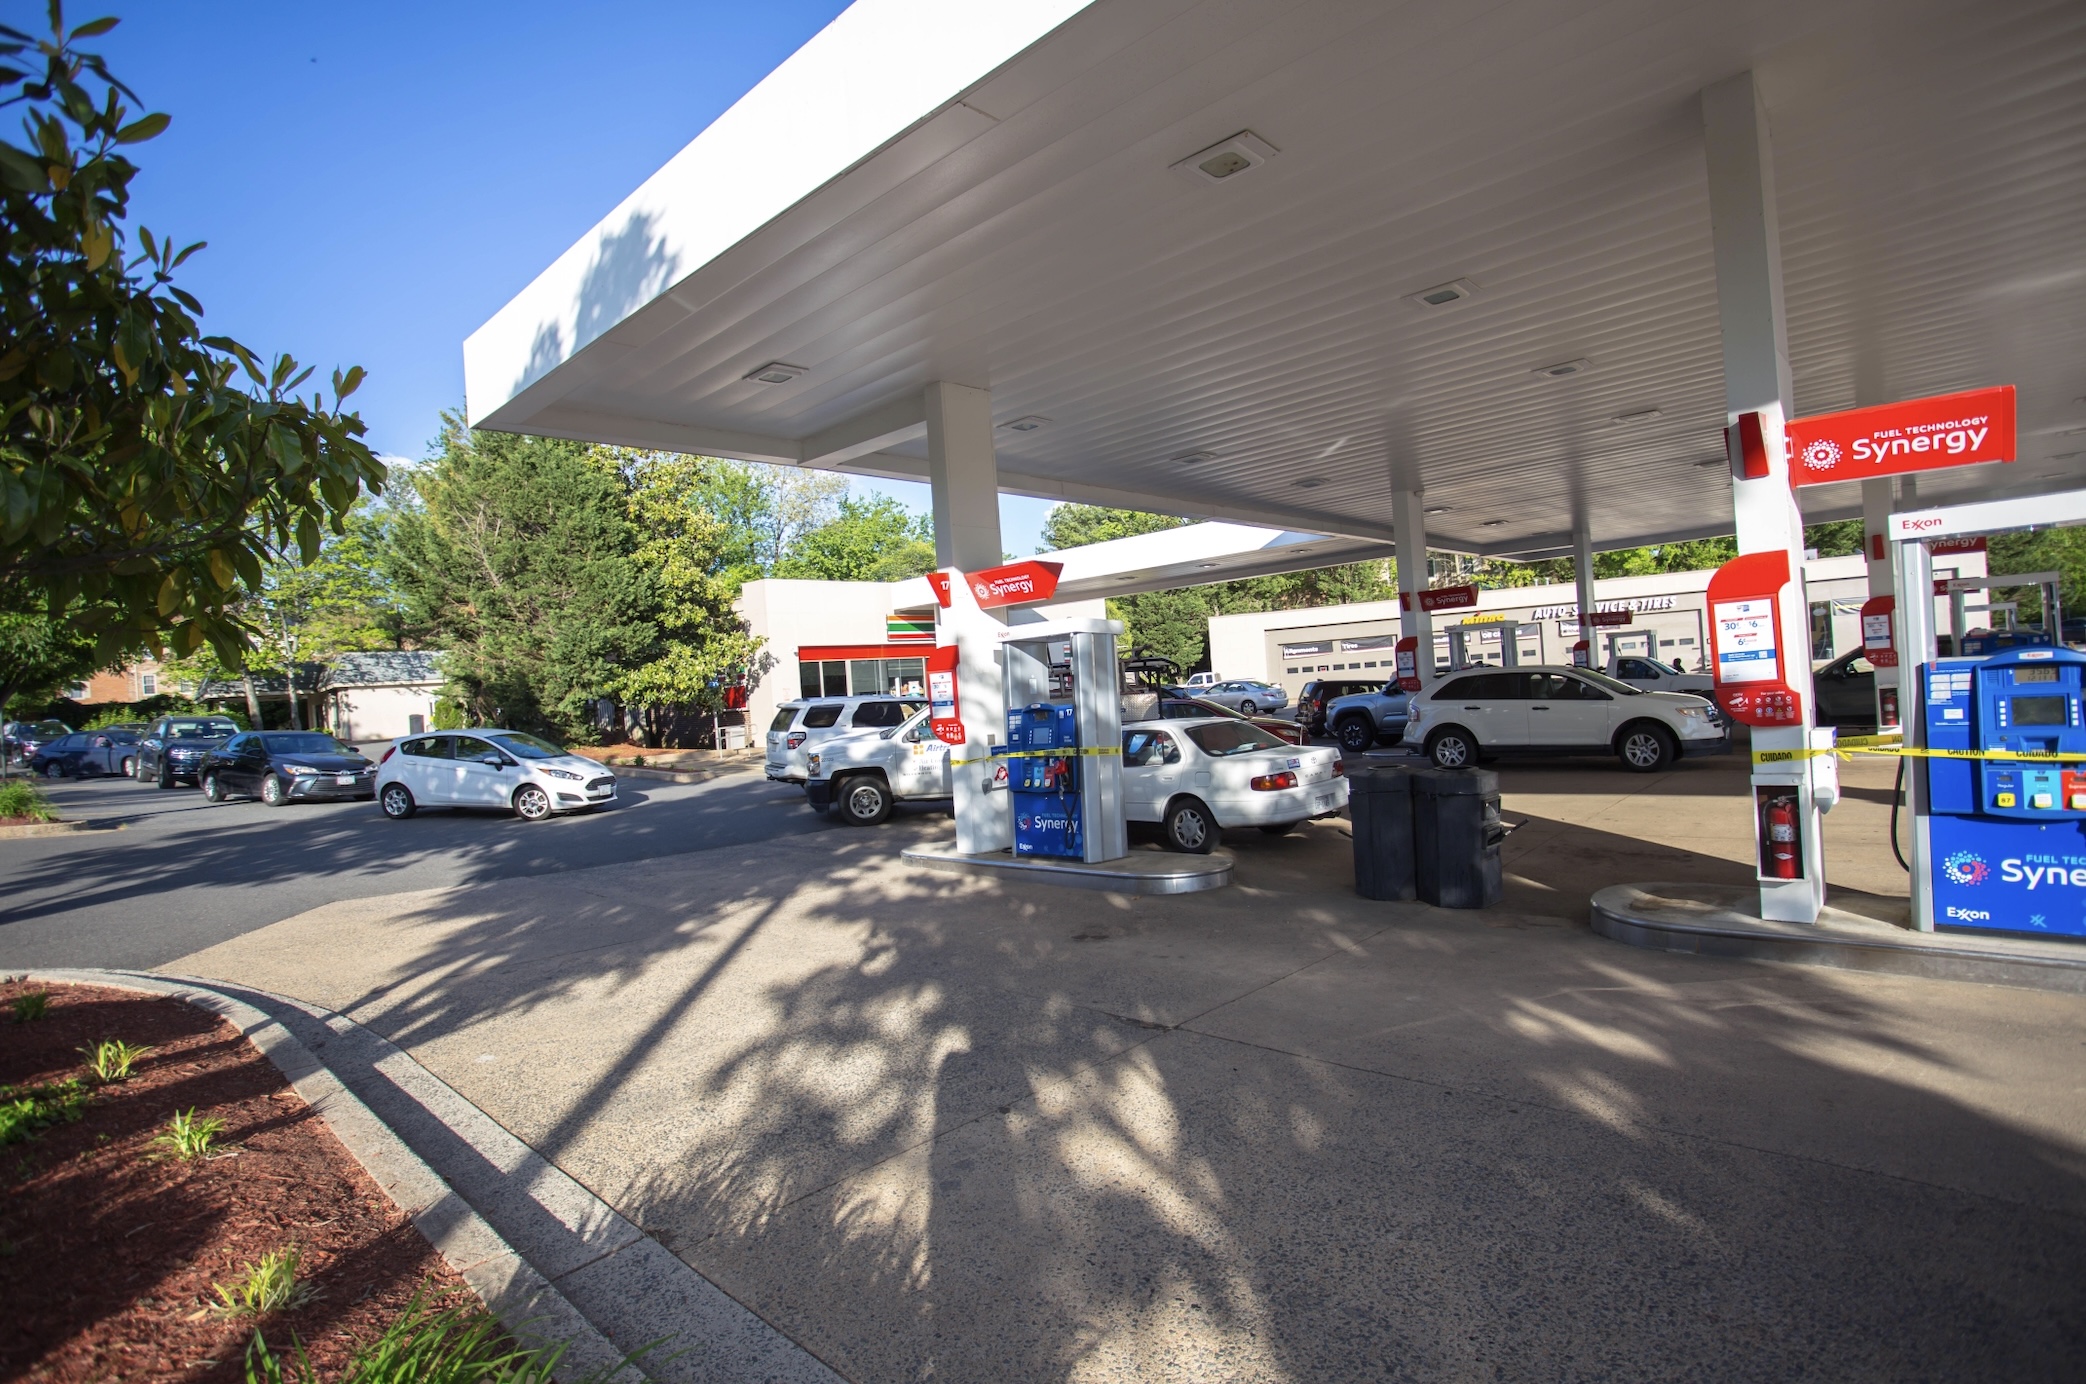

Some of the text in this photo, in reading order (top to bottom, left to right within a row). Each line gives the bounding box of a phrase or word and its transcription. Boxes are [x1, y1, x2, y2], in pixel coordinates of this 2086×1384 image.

[1874, 416, 1988, 439] FUEL TECHNOLOGY
[1852, 427, 1988, 463] Synergy
[1902, 518, 1942, 530] Exxon
[1931, 537, 1978, 550] ynergy
[940, 581, 950, 590] 17
[989, 579, 1034, 597] Synergy
[1436, 595, 1468, 606] Synergy
[1534, 605, 1567, 620] AUTO
[1571, 601, 1626, 615] SVICE
[1640, 595, 1678, 610] TIRES
[1760, 752, 1793, 763] CUIDADO
[2026, 854, 2059, 864] FUEL
[1946, 906, 1990, 922] Exxon
